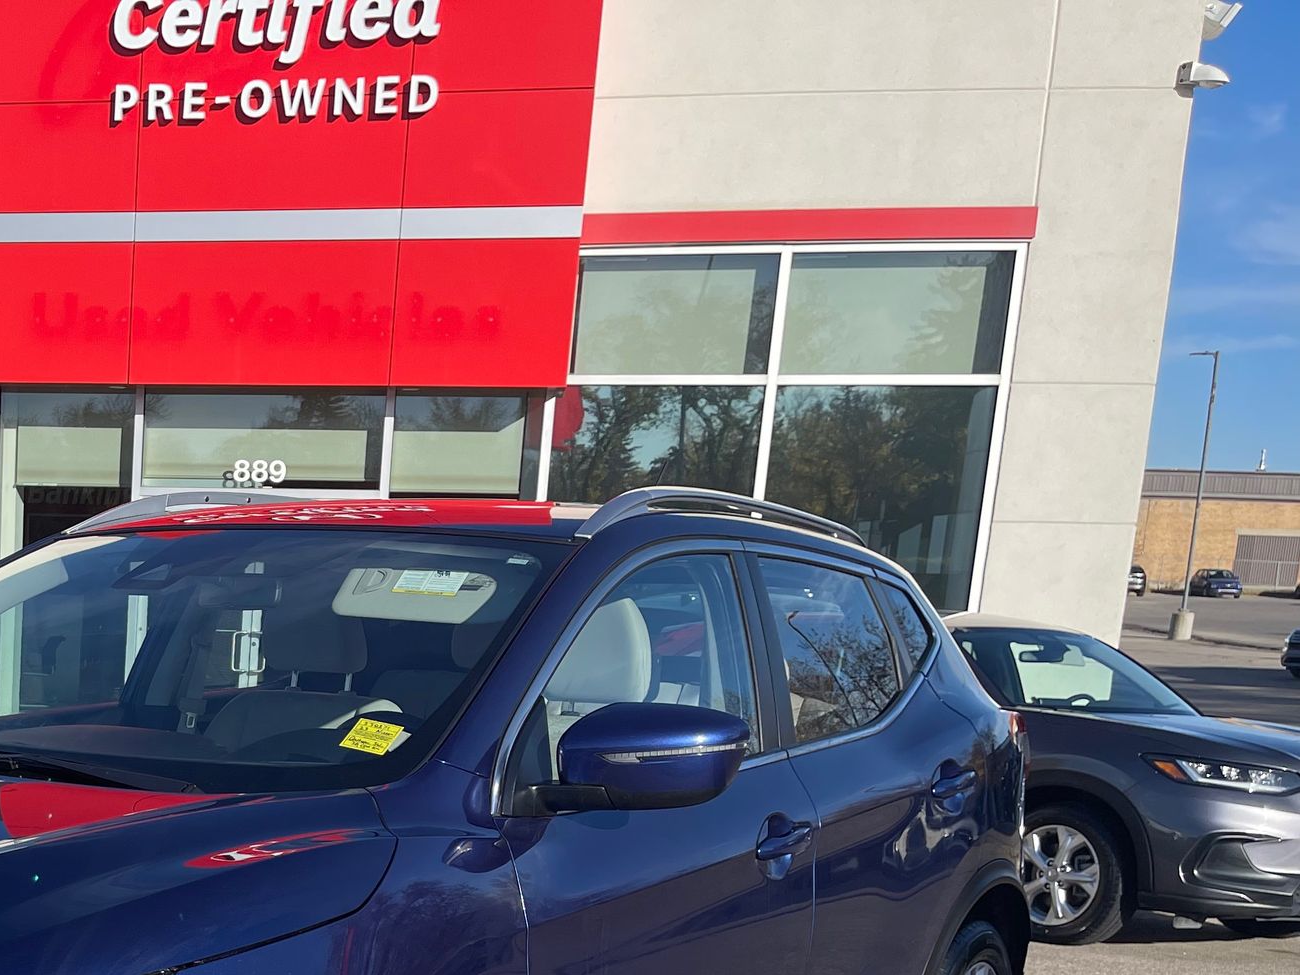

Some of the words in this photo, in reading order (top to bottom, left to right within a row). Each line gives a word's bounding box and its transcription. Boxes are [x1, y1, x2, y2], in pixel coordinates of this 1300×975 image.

[112, 0, 442, 65] Certified
[111, 74, 440, 122] PRE-OWNED
[233, 459, 287, 484] 889
